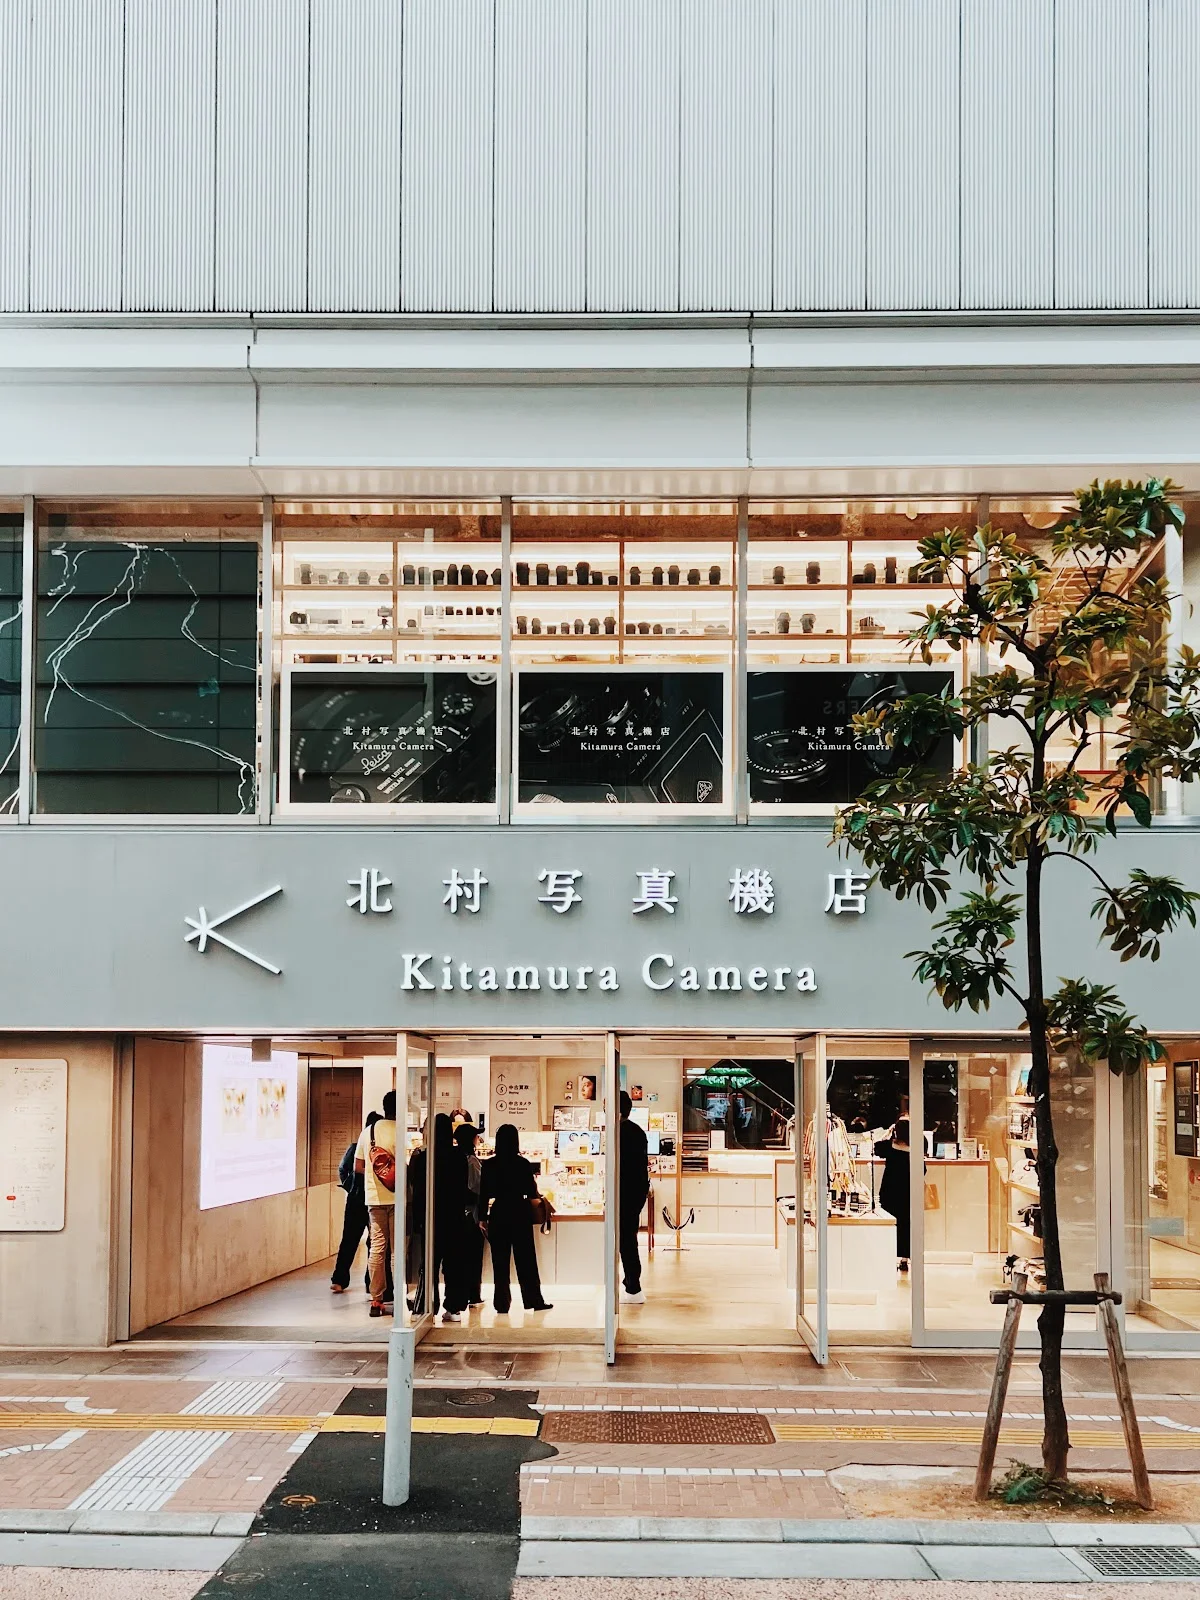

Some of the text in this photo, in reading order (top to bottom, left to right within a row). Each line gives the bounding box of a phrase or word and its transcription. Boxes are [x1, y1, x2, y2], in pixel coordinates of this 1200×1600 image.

[342, 725, 444, 736] 北村写真機店
[570, 726, 671, 736] 北村写真機店
[352, 741, 434, 750] Kitamura Camera
[580, 742, 661, 750] Kitamura Camera
[808, 742, 890, 750] Kitamura Camera
[361, 750, 392, 775] Leica
[346, 868, 870, 914] 北村写真機店
[400, 953, 818, 991] Kitamura Camera
